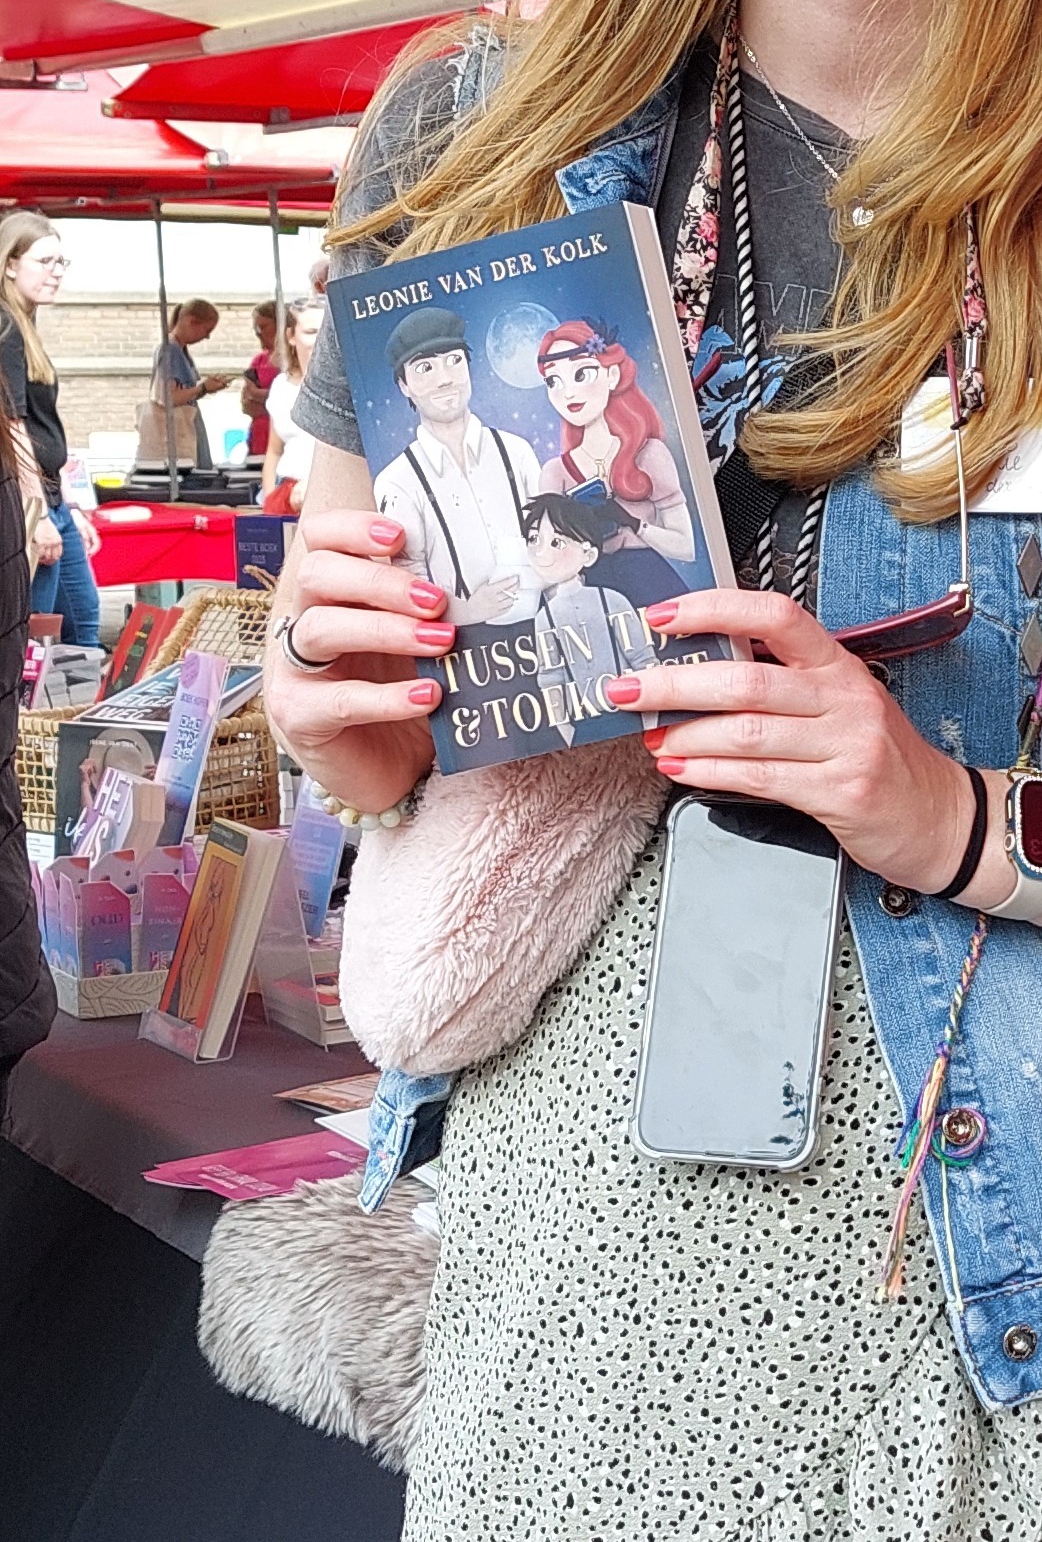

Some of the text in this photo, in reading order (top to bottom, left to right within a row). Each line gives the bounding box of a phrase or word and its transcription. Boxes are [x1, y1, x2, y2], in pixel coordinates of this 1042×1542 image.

[351, 232, 608, 320] LEONIE VAN DER KOLK
[435, 606, 697, 695] TUSSEN TI
